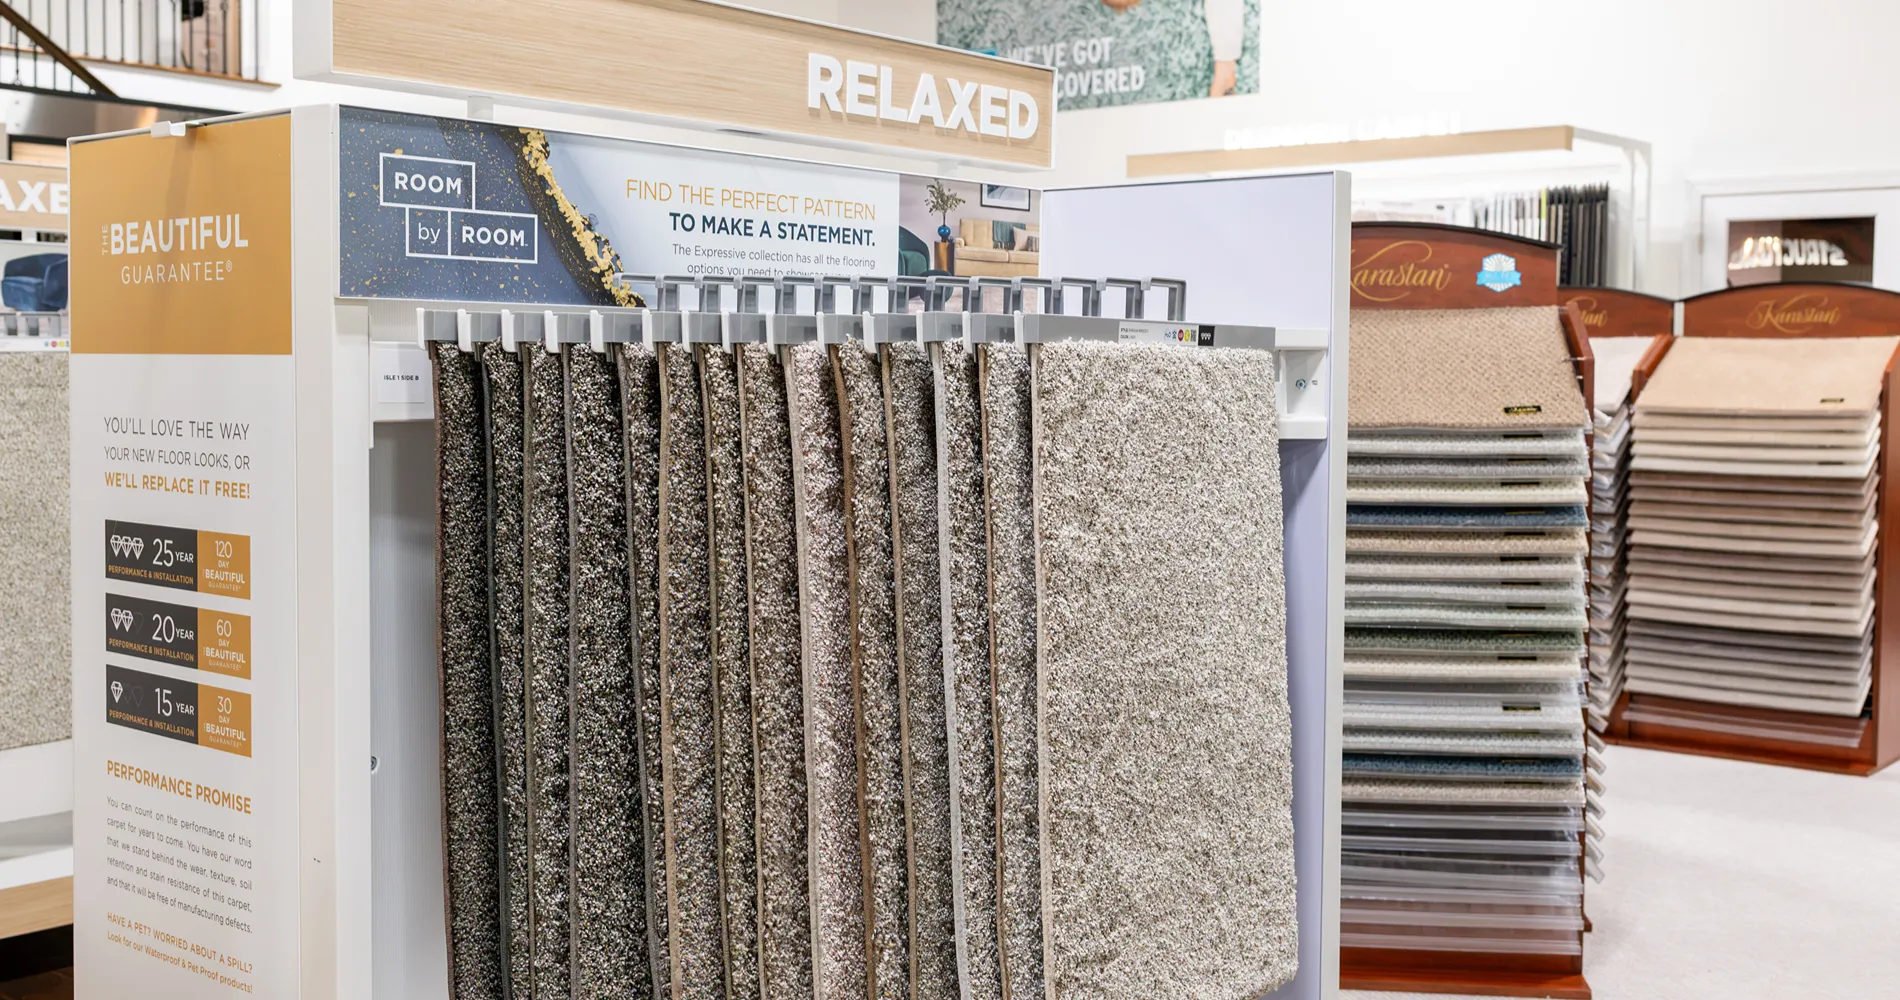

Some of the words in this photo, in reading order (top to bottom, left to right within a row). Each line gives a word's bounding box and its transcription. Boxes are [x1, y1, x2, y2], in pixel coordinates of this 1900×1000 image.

[1073, 36, 1114, 66] GOT
[807, 52, 1040, 140] RELAXED
[394, 171, 462, 195] ROOM
[626, 179, 672, 202] FIND
[679, 184, 715, 206] THE
[721, 189, 799, 214] PERFECT
[804, 197, 875, 221] PATTERN
[110, 213, 249, 255] BEAUTIFUL
[418, 223, 440, 244] by
[669, 212, 695, 232] TO
[702, 215, 754, 237] MAKE
[759, 220, 772, 238] A
[777, 221, 875, 246] STATEMENT.
[672, 244, 691, 256] The
[694, 245, 746, 261] Expressive
[749, 249, 793, 262] collection
[796, 253, 811, 264] has
[814, 254, 824, 265] all
[826, 255, 840, 266] the
[843, 256, 875, 270] flooring
[686, 263, 724, 276] options
[727, 267, 744, 276] you
[748, 267, 771, 276] need
[104, 417, 145, 435] YOU'LL
[151, 419, 183, 437] LOVE
[189, 421, 214, 439] THE
[220, 422, 250, 440] WAY
[104, 446, 130, 460] YOUR
[132, 448, 155, 463] NEW
[158, 450, 191, 466] FLOOR
[194, 452, 231, 471] LOOKS,
[234, 455, 250, 470] OR
[105, 472, 137, 489] WE'LL
[143, 475, 194, 494] REPLACE
[200, 479, 210, 495] IT
[215, 481, 250, 499] FREE!
[153, 538, 174, 567] 25
[175, 551, 194, 563] YEAR
[215, 540, 232, 558] 120
[108, 565, 147, 578] PERFORMANCE
[154, 572, 194, 584] INSTALLATION
[205, 569, 245, 584] BEAUTIFUL
[152, 614, 175, 643] 20
[175, 628, 194, 640] YEAR
[216, 619, 232, 637] 60
[109, 638, 148, 652] PERFORMANCE
[154, 647, 194, 662] INSTALLATION
[205, 647, 246, 663] BEAUTIFUL
[218, 639, 230, 647] DAY
[155, 687, 172, 716] 15
[176, 702, 194, 715] YEAR
[217, 696, 232, 714] 30
[109, 709, 148, 727] PERFORMANCE
[154, 721, 194, 737] INSTALLATION
[206, 723, 246, 741] BEAUTIFUL
[219, 715, 230, 724] DAY
[107, 760, 192, 798] PERFORMANCE
[196, 784, 251, 814] PROMISE
[107, 796, 118, 808] You
[121, 802, 132, 812] can
[135, 806, 153, 819] count
[156, 812, 164, 821] on
[167, 814, 178, 826] the
[181, 820, 225, 840] performance
[228, 833, 235, 843] of
[239, 835, 252, 848] this
[107, 816, 126, 830] carpet
[128, 822, 136, 833] for
[139, 826, 155, 840] years
[157, 832, 164, 842] to
[166, 835, 185, 848] come.
[187, 841, 200, 853] You
[202, 845, 217, 859] have
[220, 851, 232, 863] our
[234, 855, 252, 869] word
[107, 836, 119, 848] that
[121, 842, 130, 851] we
[132, 845, 149, 858] stand
[152, 851, 174, 866] behind
[176, 859, 187, 870] the
[189, 863, 208, 878] wear,
[210, 869, 237, 887] texture,
[239, 879, 252, 891] soil
[107, 857, 134, 872] retention
[136, 866, 147, 877] and
[150, 870, 165, 884] stain
[167, 877, 200, 895] resistance
[203, 888, 210, 898] of
[212, 890, 224, 903] this
[227, 896, 252, 913] carpet,
[107, 876, 118, 886] and
[119, 879, 131, 892] that
[132, 884, 136, 893] it
[137, 886, 146, 897] will
[148, 890, 156, 900] be
[157, 892, 168, 905] free
[170, 898, 177, 907] of
[177, 901, 224, 925] manufacturing
[225, 916, 253, 934] defects.
[107, 911, 125, 928] HAVE
[127, 919, 132, 928] A
[134, 921, 151, 937] PET?
[153, 930, 188, 951] WORRIED
[190, 944, 217, 961] ABOUT
[219, 954, 224, 965] A
[227, 956, 253, 974] SPILL?
[107, 931, 122, 944] Look
[123, 936, 131, 948] for
[133, 942, 143, 952] our
[145, 944, 180, 967] Waterproof
[182, 959, 186, 969] &
[188, 961, 198, 974] Pet
[200, 966, 219, 981] Proof
[220, 975, 253, 994] products!
